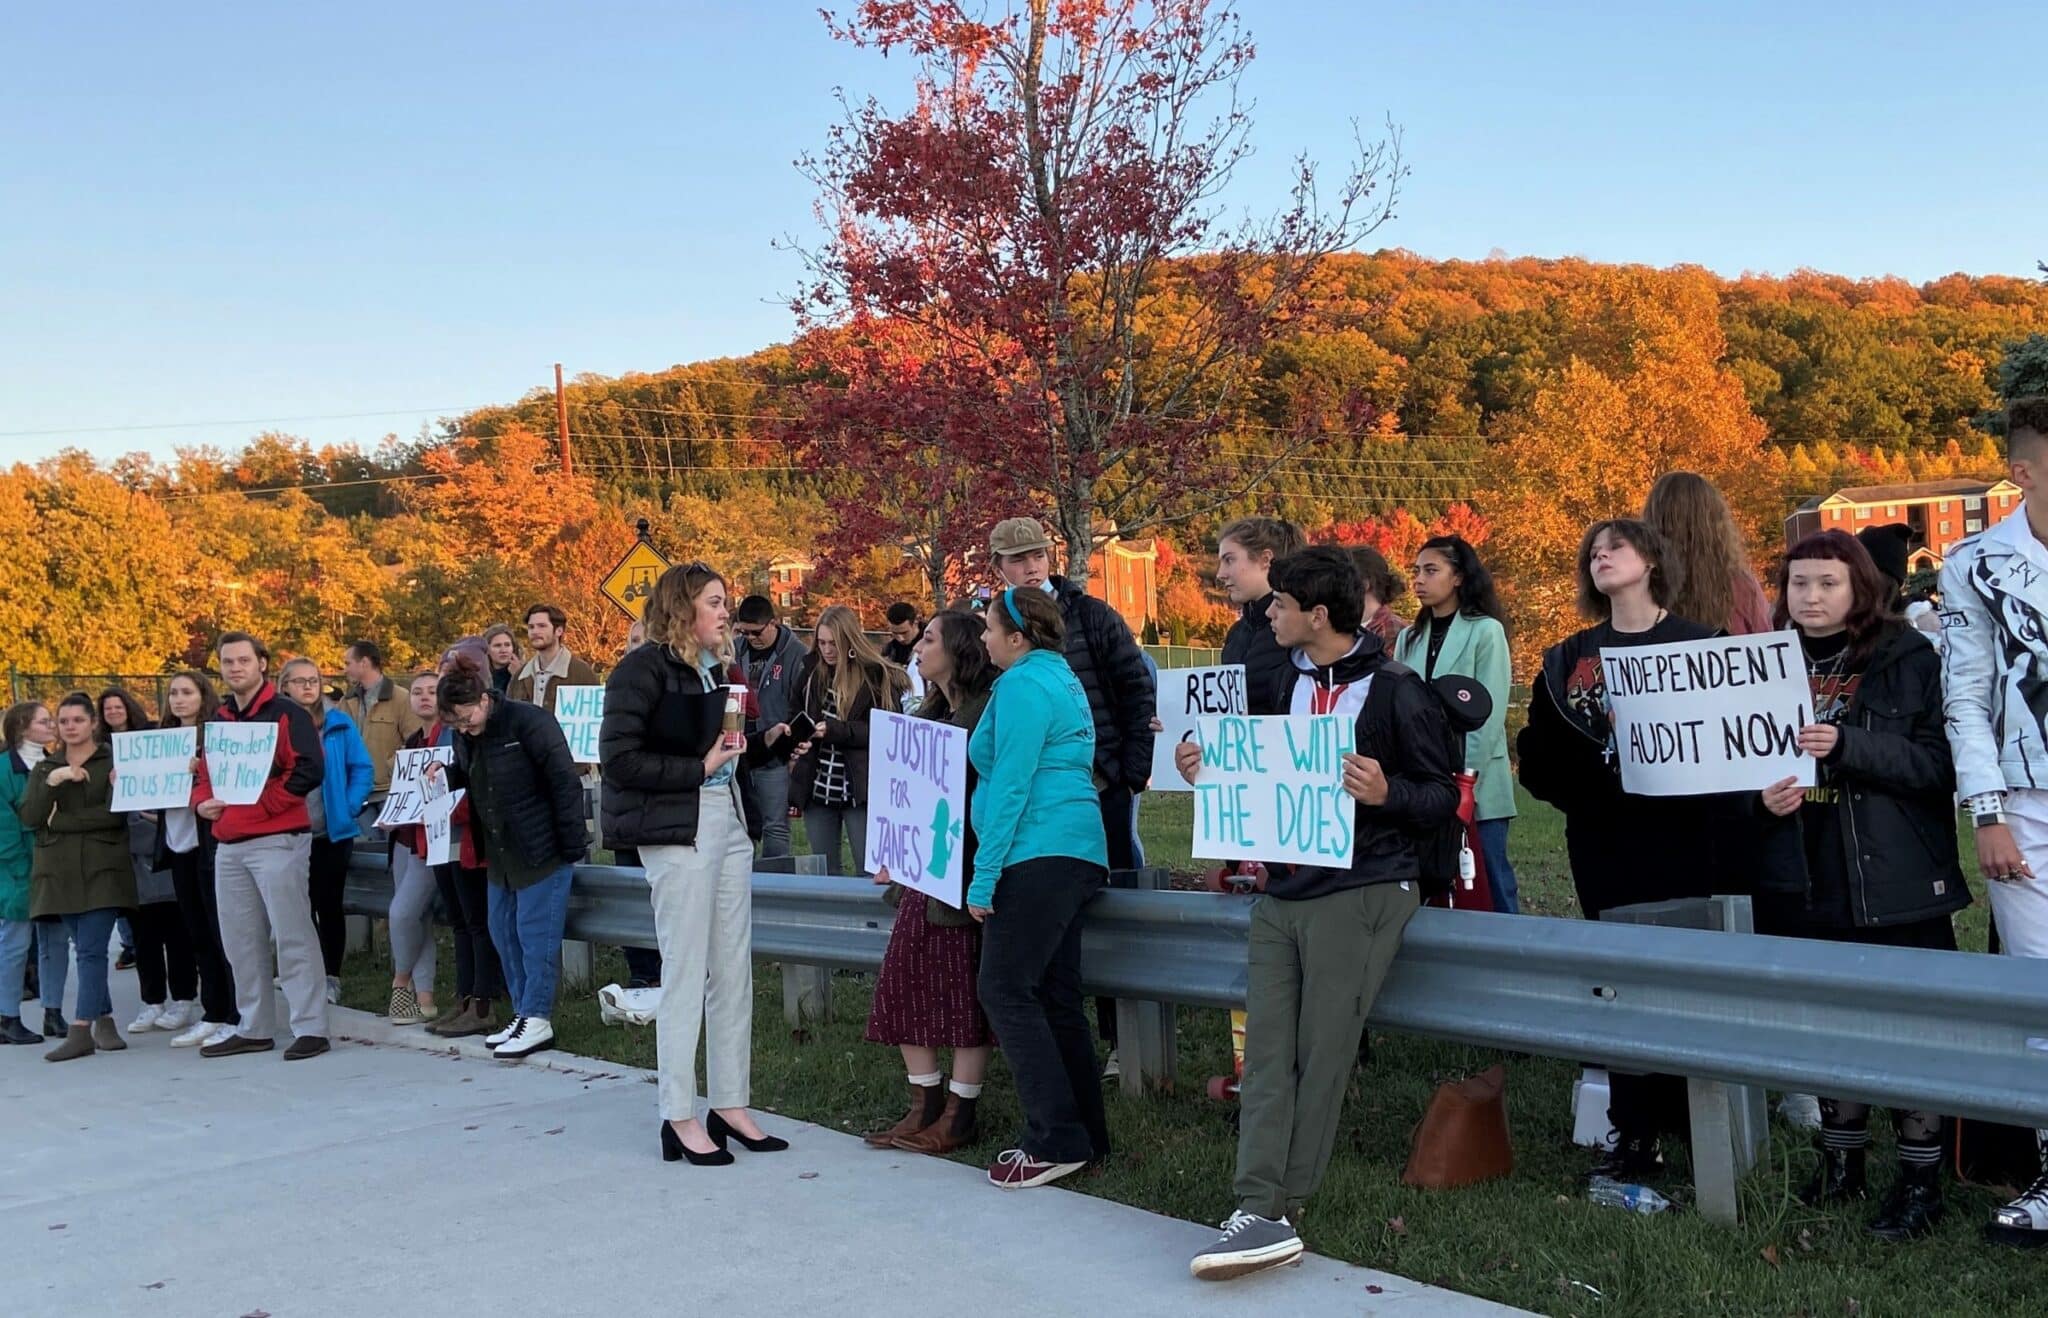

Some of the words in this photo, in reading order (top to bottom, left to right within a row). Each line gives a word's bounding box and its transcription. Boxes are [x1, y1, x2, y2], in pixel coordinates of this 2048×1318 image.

[1605, 642, 1789, 697] INDEPENDENT
[118, 733, 192, 762] LISTENING
[886, 715, 952, 794] JUSTICE
[1284, 715, 1354, 782] WITH
[1630, 721, 1704, 764] AUDIT
[1721, 703, 1805, 761] NOW
[120, 775, 138, 798] TO
[142, 774, 158, 796] US
[381, 790, 416, 823] THE
[890, 777, 911, 809] FOR
[1194, 783, 1256, 847] THE
[871, 816, 923, 883] JANES
